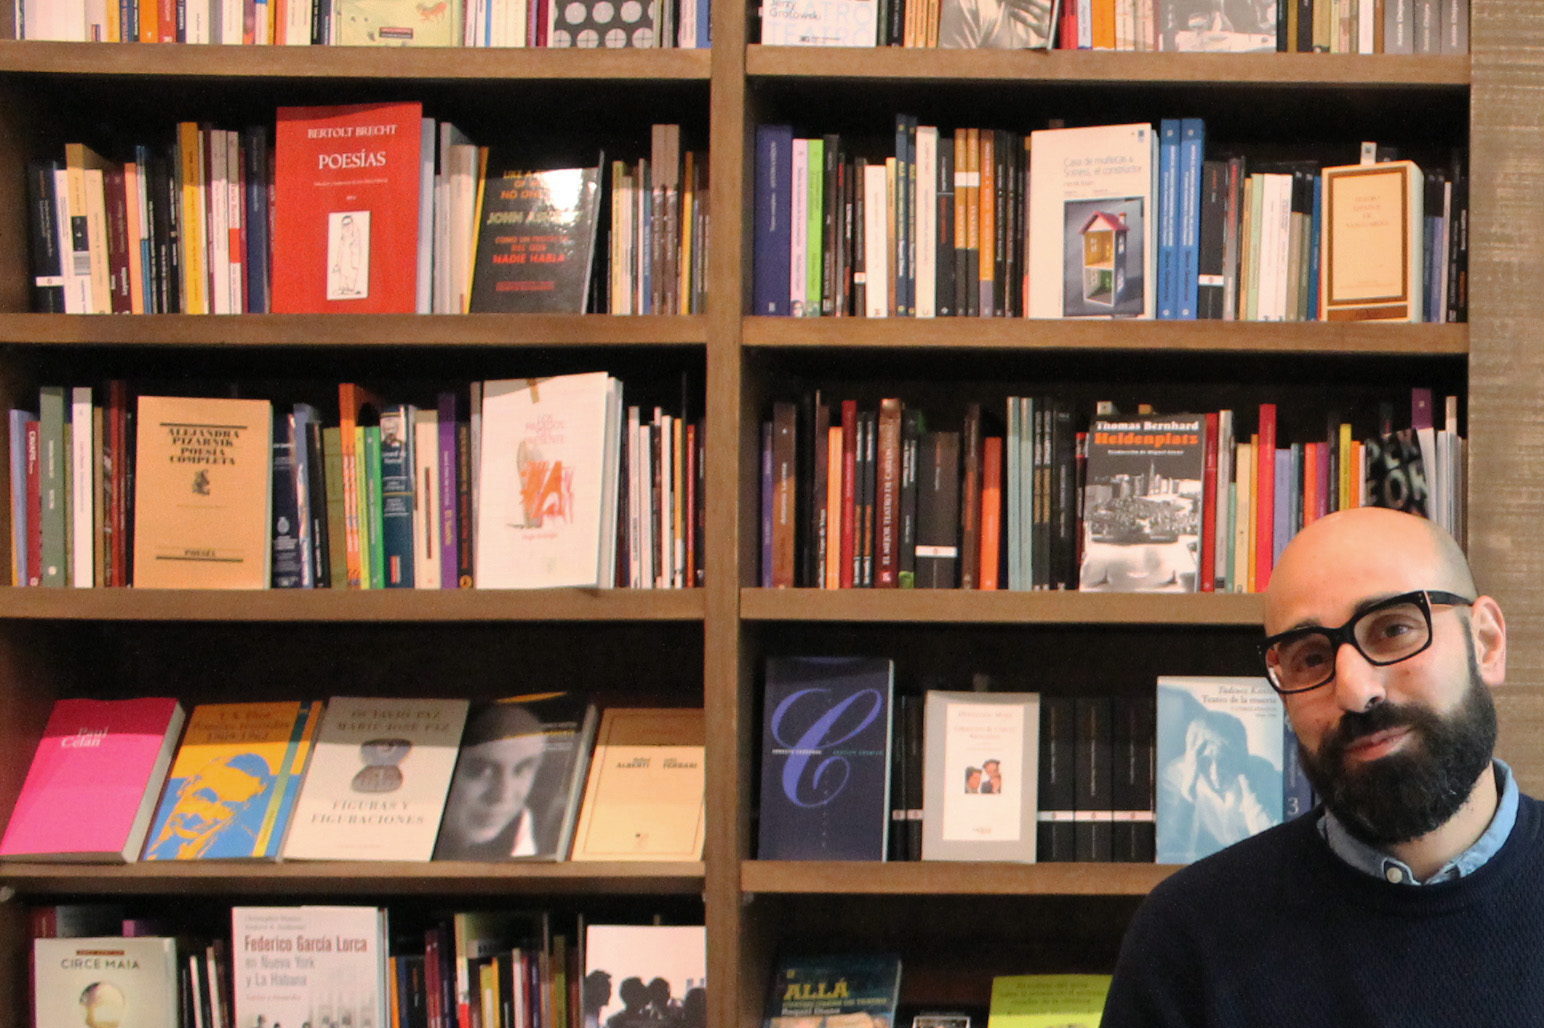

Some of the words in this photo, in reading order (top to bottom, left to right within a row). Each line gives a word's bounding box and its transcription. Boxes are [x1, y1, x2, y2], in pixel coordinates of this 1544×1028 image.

[308, 126, 353, 138] BERTOLT
[356, 124, 398, 136] BRECHT
[318, 149, 386, 170] POESÍAS
[1096, 421, 1141, 430] Thomas
[1143, 420, 1199, 431] Bernhard
[167, 428, 240, 439] ALEJANDRA
[1095, 432, 1198, 448] Heldenplatz
[172, 438, 234, 448] PIZARNIK
[245, 935, 292, 952] Federico
[297, 935, 331, 952] García
[336, 936, 367, 952] Lorca
[60, 958, 100, 970] CIRCE
[105, 959, 139, 970] MAIA
[261, 956, 290, 968] Nueva
[295, 956, 314, 968] York
[785, 978, 850, 999] ALLÁ
